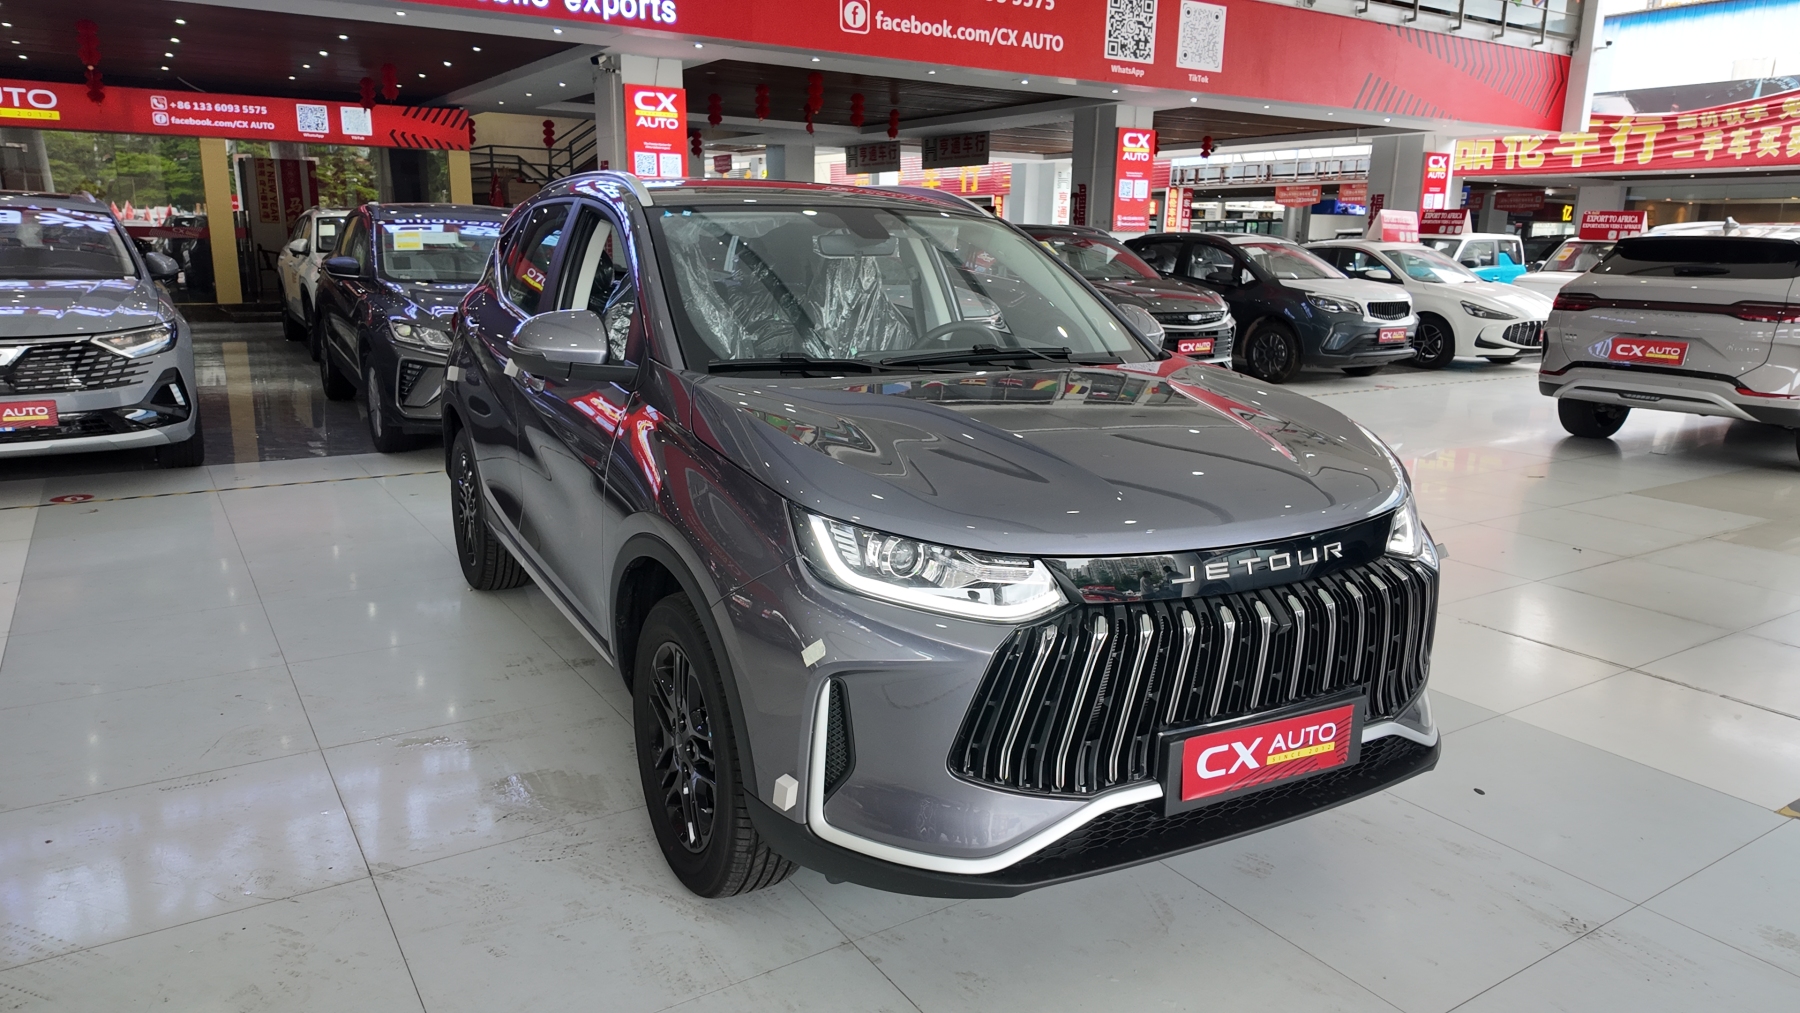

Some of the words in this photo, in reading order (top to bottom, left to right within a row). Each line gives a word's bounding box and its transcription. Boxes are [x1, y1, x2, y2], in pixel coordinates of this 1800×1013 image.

[875, 10, 1018, 46] facebook.com/CX
[1021, 31, 1064, 52] AUTO
[1110, 64, 1145, 78] WhatsApp
[1188, 73, 1209, 83] TikTok
[0, 86, 58, 109] TO
[634, 90, 678, 113] CX
[169, 101, 191, 110] +86
[193, 102, 213, 111] 133
[214, 103, 241, 113] 6093
[242, 105, 268, 114] 5575
[170, 116, 249, 129] facebook.com/CX
[250, 121, 275, 130] AUTO
[636, 116, 679, 130] AUTO
[939, 134, 986, 156] 亨通车行
[1122, 132, 1151, 149] CX
[859, 144, 898, 162] 亨通车行
[1122, 151, 1150, 162] AUTO
[1429, 156, 1447, 168] CX
[1586, 214, 1608, 223] EXPORT
[1608, 215, 1617, 223] TO
[1617, 215, 1639, 223] AFRICA
[1381, 331, 1393, 340] CX
[1179, 342, 1195, 353] CX
[1195, 340, 1211, 348] AUTO
[1616, 343, 1645, 357] CX
[1646, 346, 1681, 356] AUTO
[2, 406, 49, 417] AUTO
[1171, 541, 1344, 585] JETOUR
[1196, 736, 1264, 780] CX
[1267, 722, 1337, 754] AUTO
[1271, 751, 1301, 763] SINCE
[1308, 743, 1332, 754] 2012
